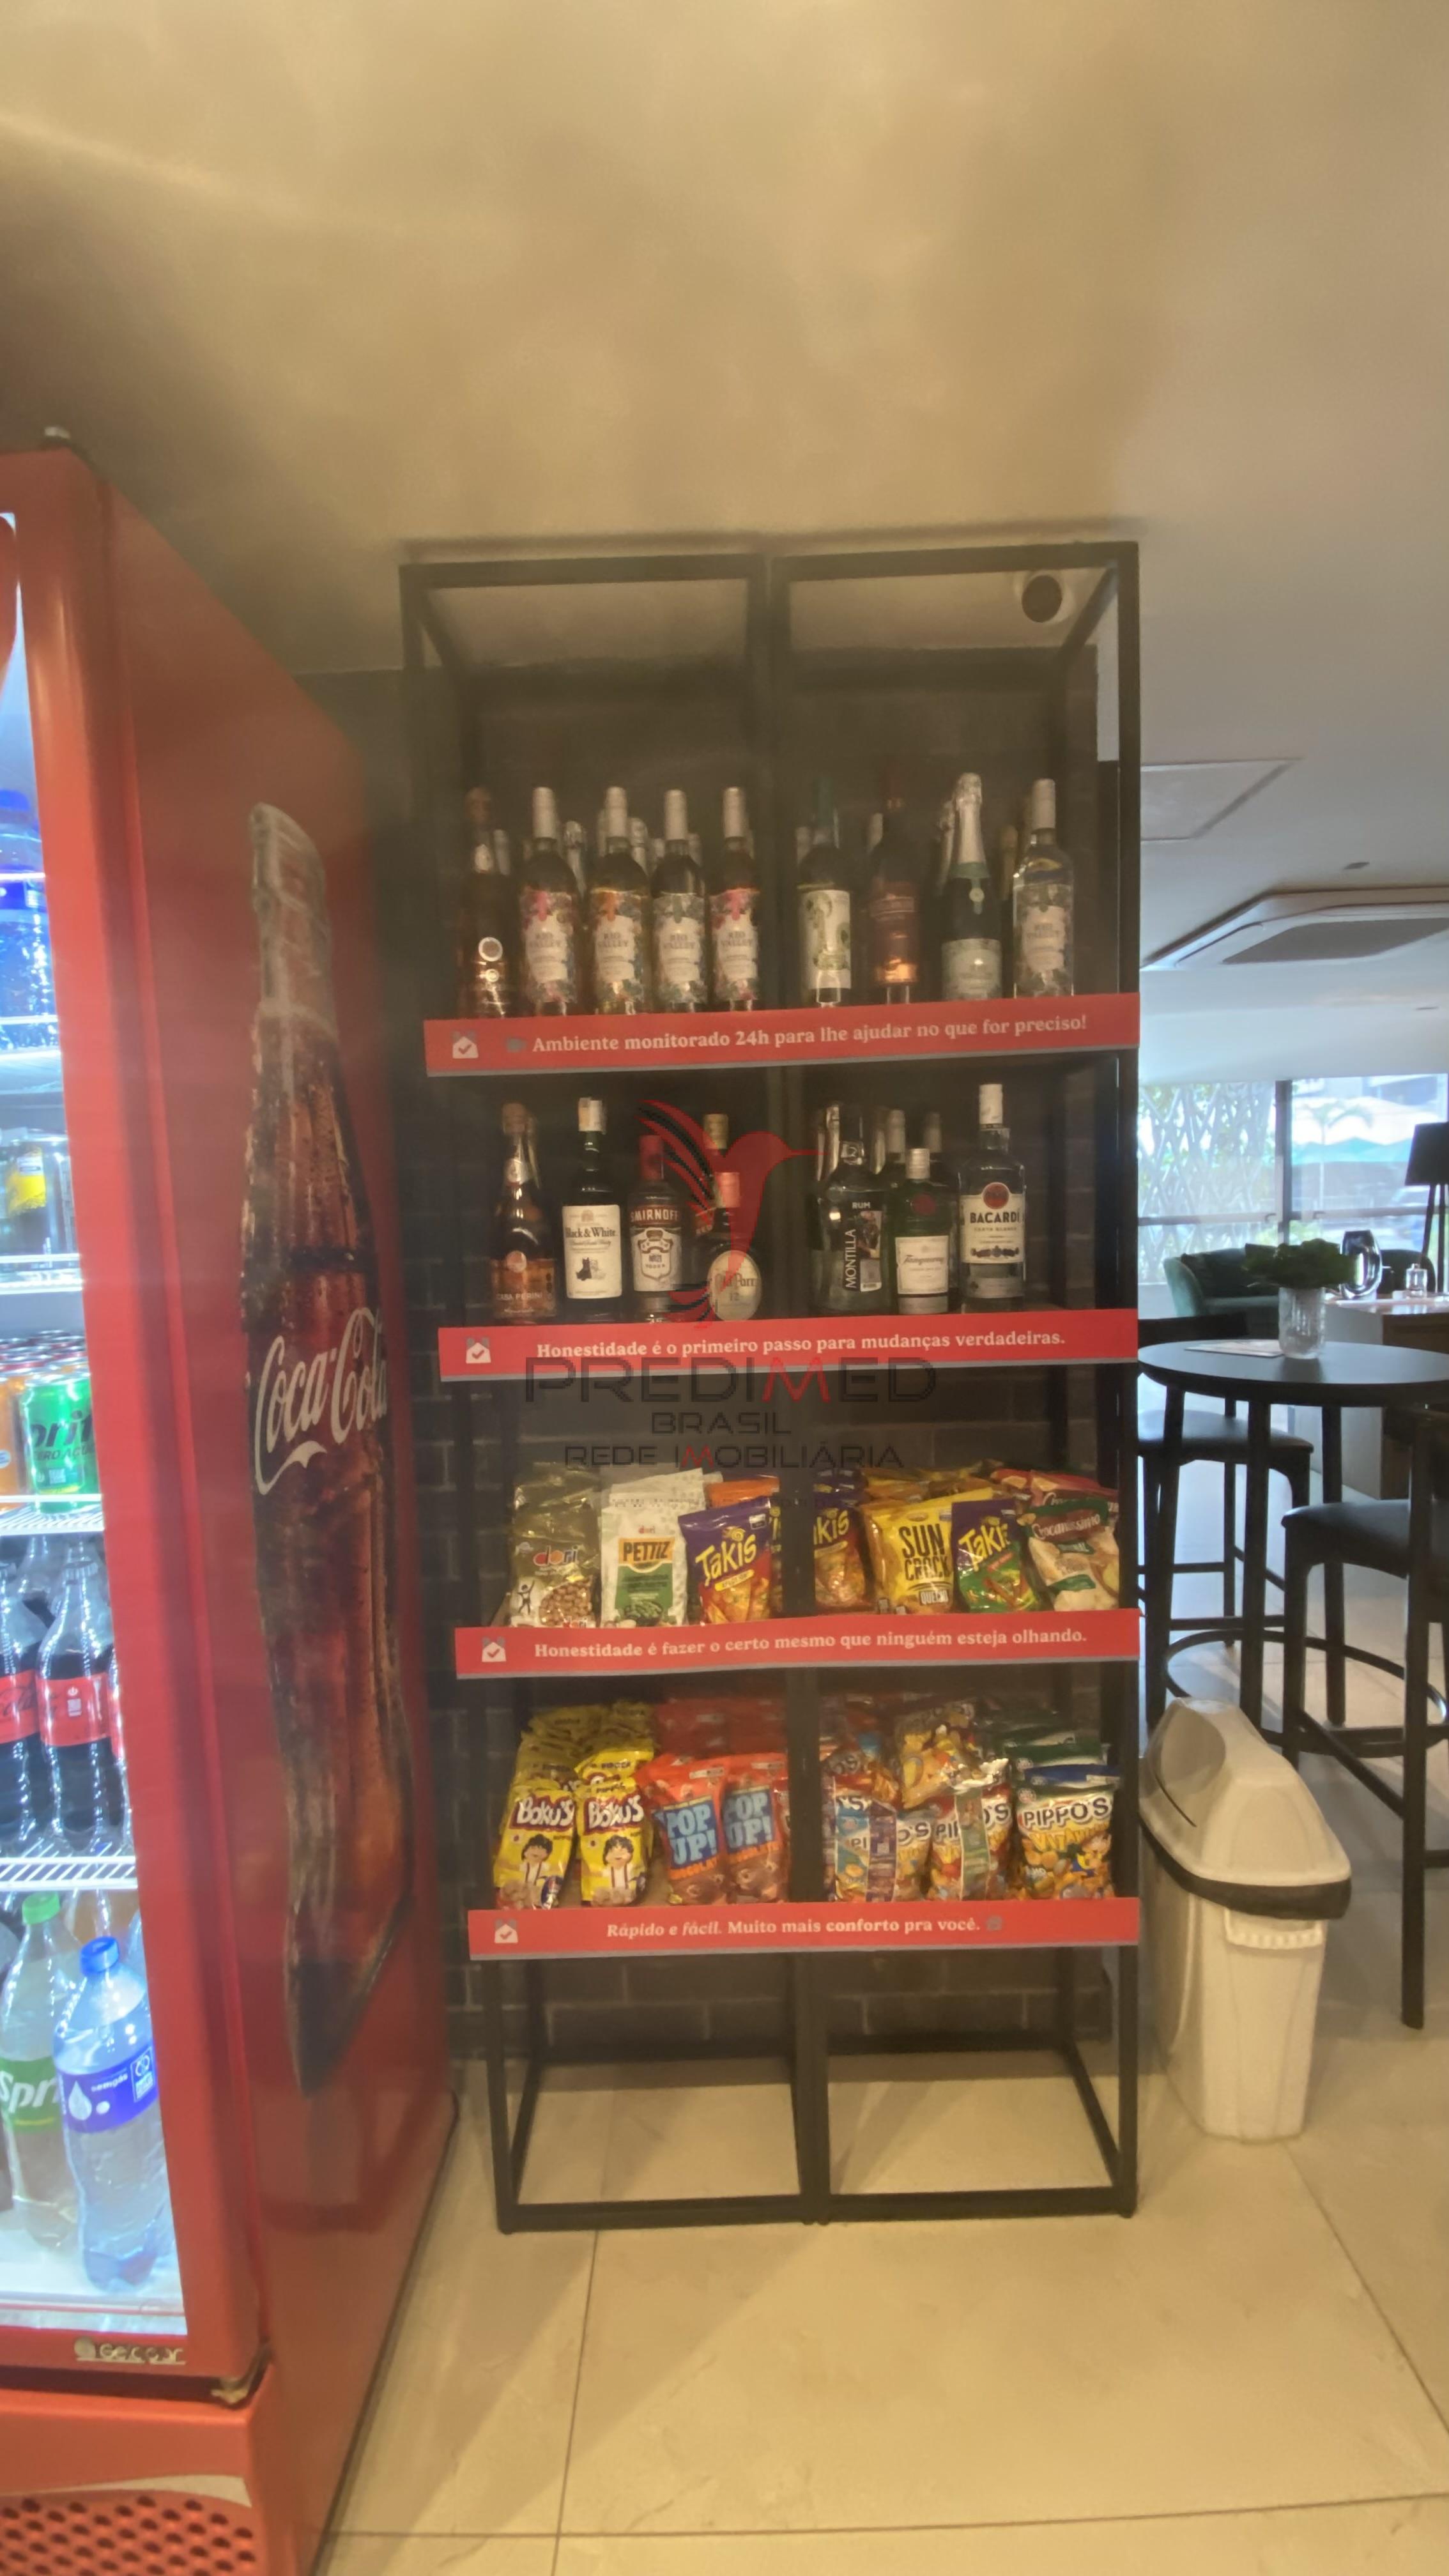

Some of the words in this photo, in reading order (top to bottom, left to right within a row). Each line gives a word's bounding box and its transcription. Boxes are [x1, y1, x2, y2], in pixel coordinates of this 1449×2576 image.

[532, 1036, 619, 1053] Ambiente
[624, 1031, 730, 1050] monitorado
[735, 1030, 769, 1046] 24h
[775, 1030, 815, 1048] para
[820, 1027, 847, 1042] lhe
[853, 1023, 912, 1043] ajudar
[917, 1024, 940, 1037] no
[945, 1022, 977, 1039] que
[983, 1018, 1009, 1034] for
[1015, 1015, 1087, 1037] preciso!
[630, 1208, 679, 1223] SMIRNOFF
[845, 1229, 857, 1289] MONTILLA
[537, 1341, 647, 1358] Honestidade
[652, 1340, 662, 1355] é
[666, 1343, 677, 1354] o
[682, 1338, 758, 1358] primeiro
[763, 1336, 812, 1355] passo
[816, 1337, 855, 1354] para
[861, 1334, 951, 1351] mudanças
[955, 1330, 1066, 1347] verdadeiras.
[256, 1307, 387, 1496] Coca-Cola
[898, 1523, 946, 1559] SUN
[532, 1545, 579, 1567] dori
[694, 1533, 757, 1588] Takis
[534, 1643, 643, 1657] Honestidade
[648, 1642, 658, 1655] é
[662, 1641, 705, 1655] fazer
[710, 1642, 720, 1653] o
[725, 1637, 770, 1652] certo
[774, 1636, 836, 1650] mesmo
[840, 1633, 871, 1650] que
[877, 1630, 953, 1649] ninguém
[957, 1630, 1008, 1648] esteja
[1012, 1628, 1087, 1645] olhando.
[1024, 1797, 1109, 1826] PIPPO'S
[606, 1922, 664, 1940] Rápido
[668, 1924, 678, 1936] e
[682, 1920, 722, 1936] fácil.
[728, 1920, 778, 1934] Muito
[781, 1918, 822, 1933] mais
[825, 1918, 900, 1932] conforto
[905, 1919, 933, 1935] pra
[937, 1917, 981, 1931] você.
